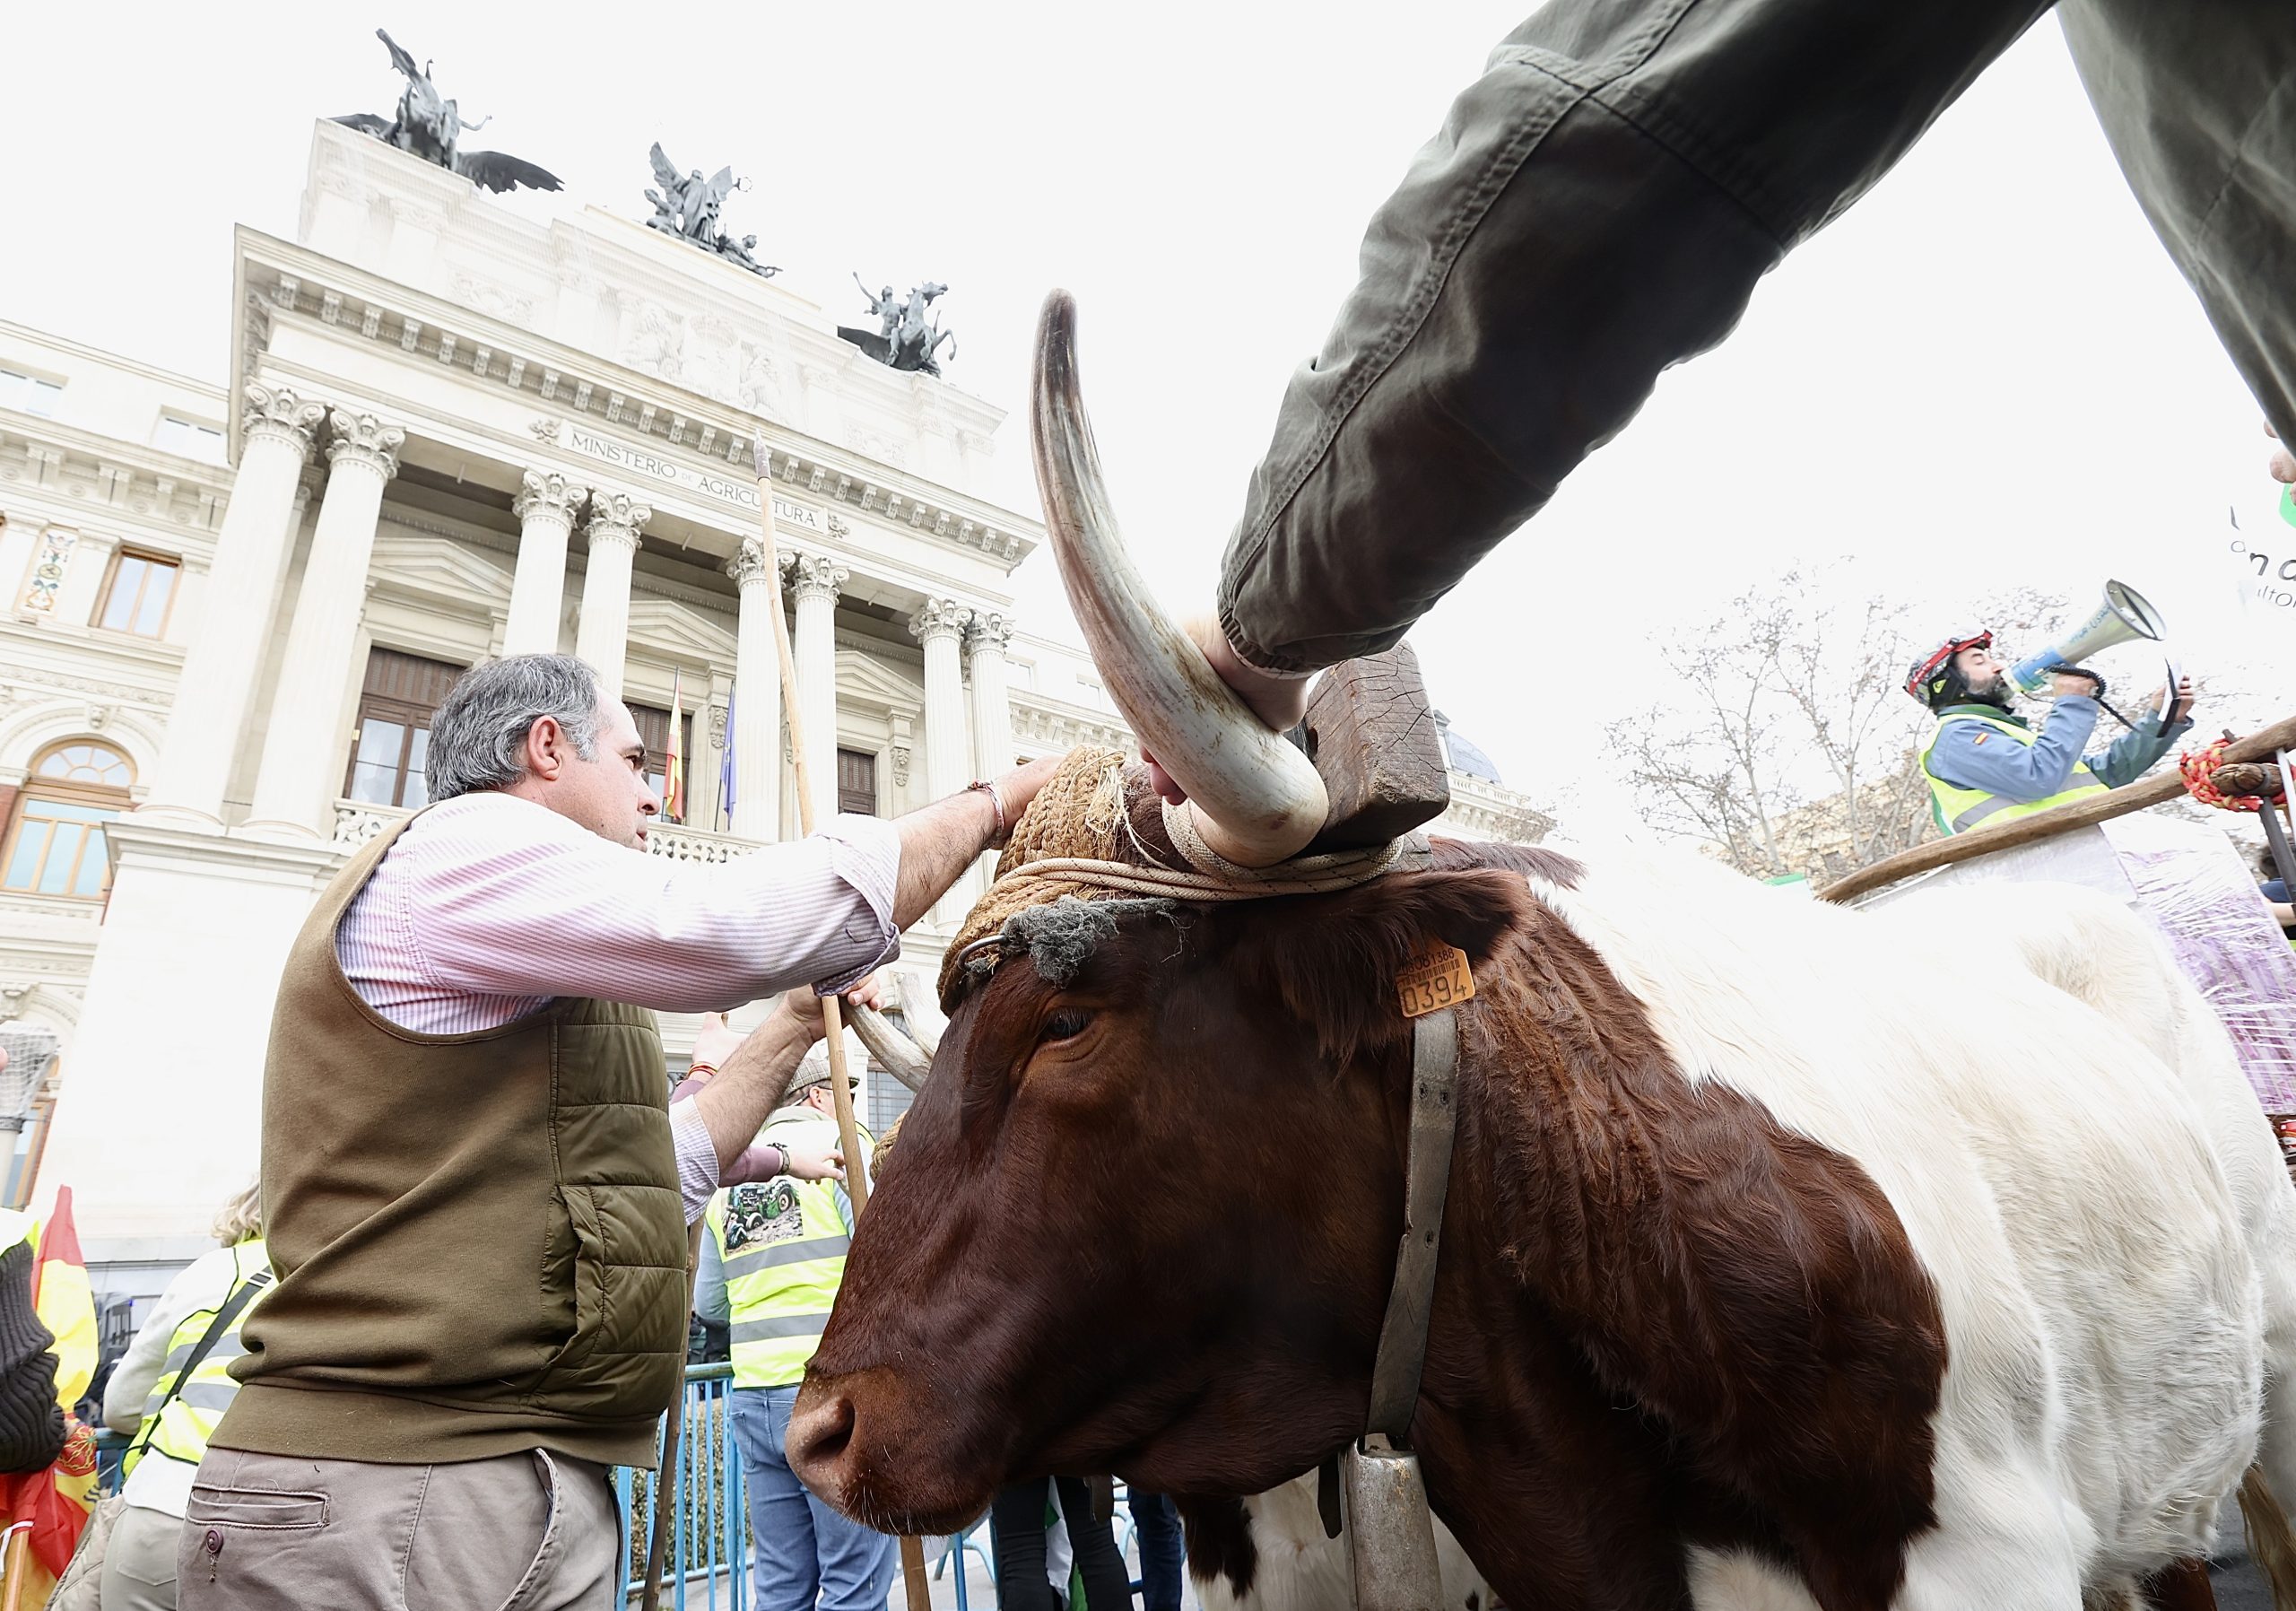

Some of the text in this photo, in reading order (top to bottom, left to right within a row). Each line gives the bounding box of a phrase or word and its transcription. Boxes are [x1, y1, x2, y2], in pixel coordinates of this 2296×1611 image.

[572, 433, 816, 527] MINISTERIO DE AGRICUTURA
[1402, 971, 1467, 1014] 0394
